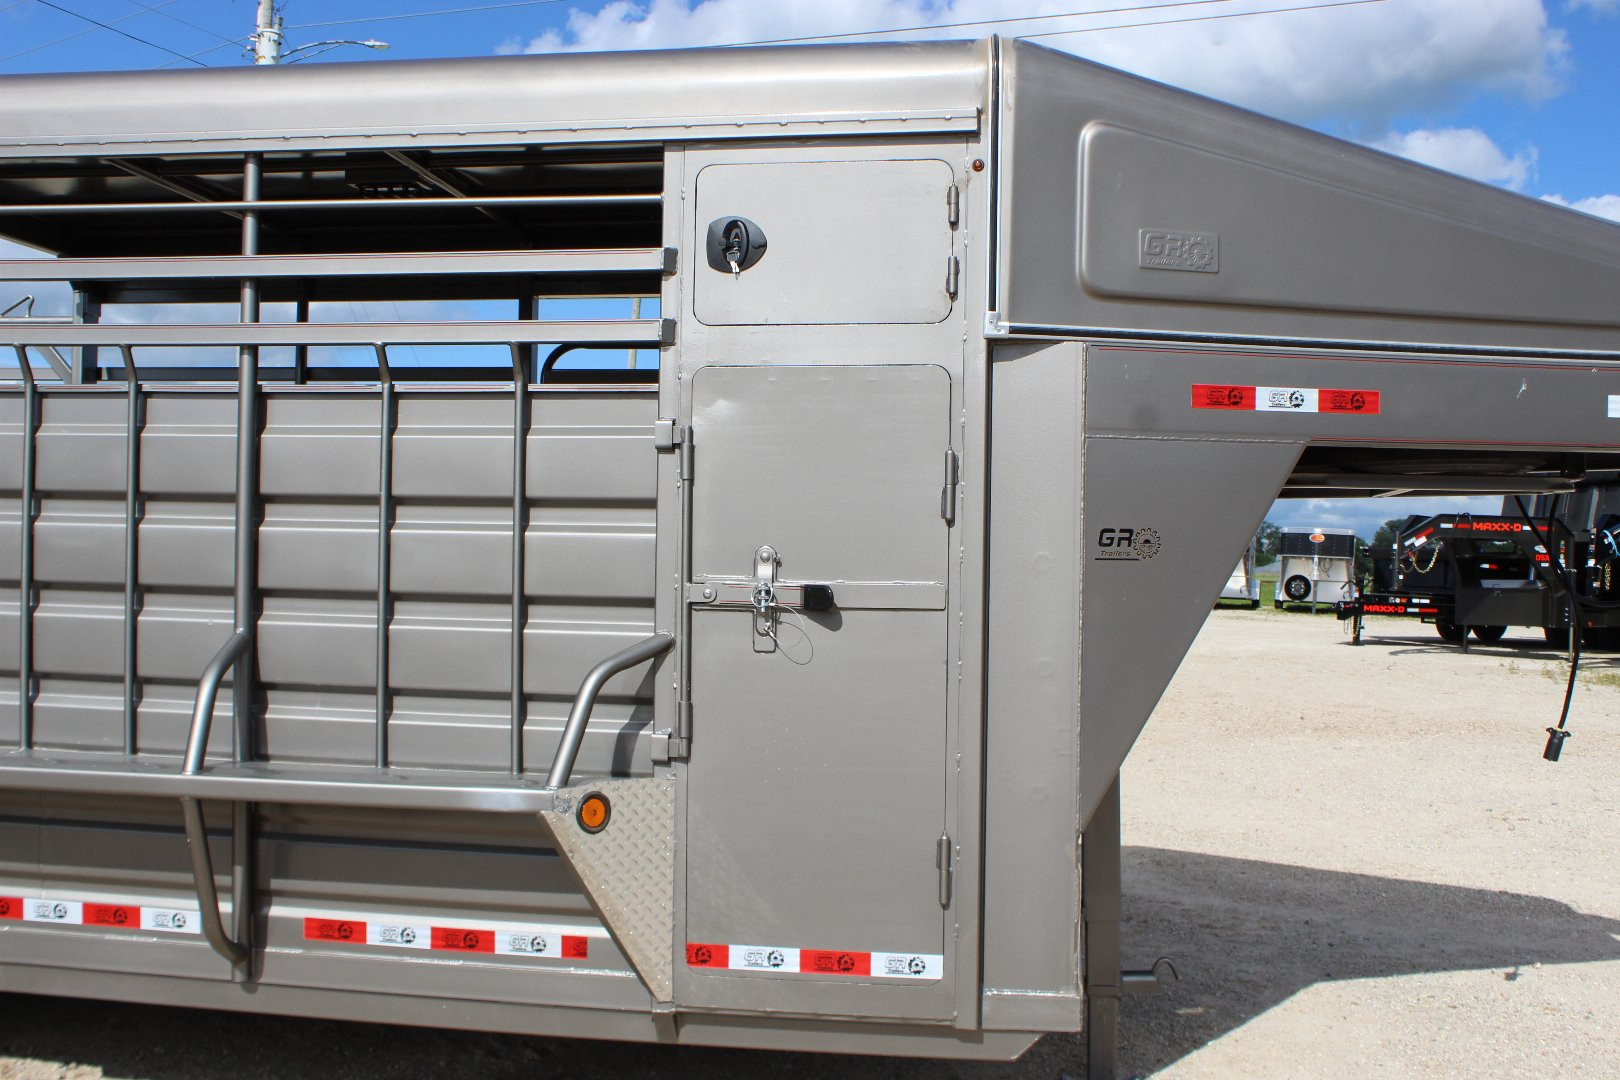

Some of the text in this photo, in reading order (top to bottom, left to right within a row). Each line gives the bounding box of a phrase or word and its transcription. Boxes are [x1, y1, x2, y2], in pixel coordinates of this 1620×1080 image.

[1144, 232, 1184, 257] GR
[1268, 389, 1288, 403] GR
[1472, 522, 1522, 532] MAXX-D
[1098, 527, 1134, 548] GR
[1363, 604, 1405, 613] MAXX-D
[379, 926, 399, 939] GR
[508, 935, 530, 948] GR
[743, 948, 766, 962] GR
[885, 956, 908, 969] GR
